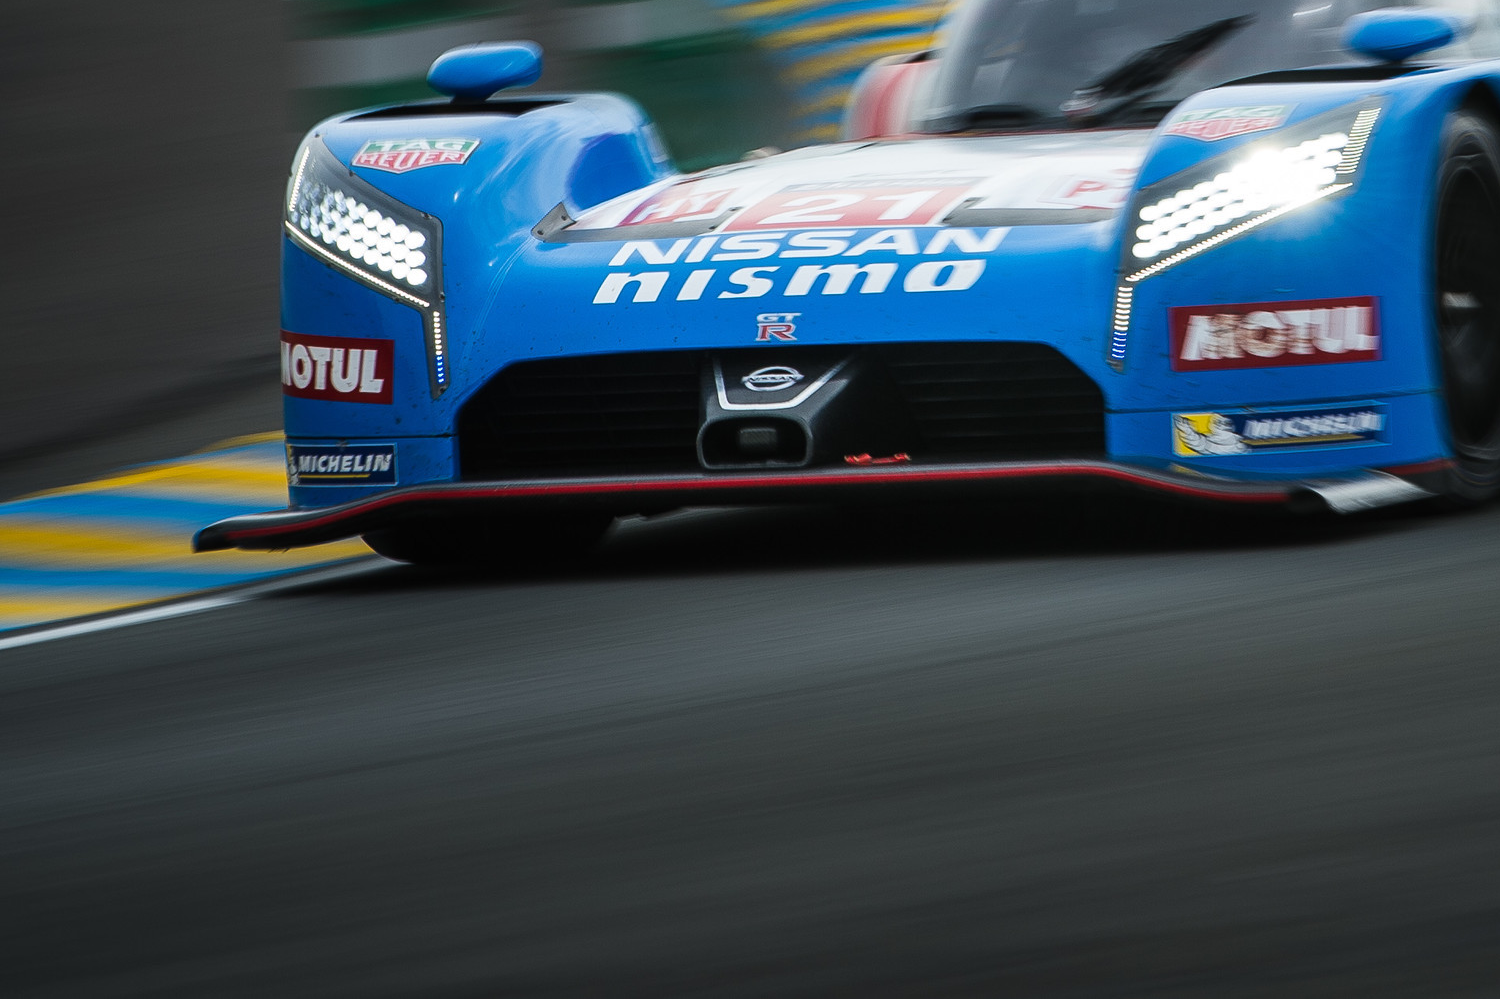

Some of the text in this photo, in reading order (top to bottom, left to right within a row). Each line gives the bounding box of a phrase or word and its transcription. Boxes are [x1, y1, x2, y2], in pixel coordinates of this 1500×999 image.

[375, 138, 466, 152] TAG
[359, 151, 461, 170] HEUER
[756, 190, 943, 225] 21
[608, 227, 1012, 266] NISSAN
[1180, 306, 1379, 361] MOTUL
[749, 374, 799, 383] NISSAN
[299, 454, 393, 473] MICHELIN
